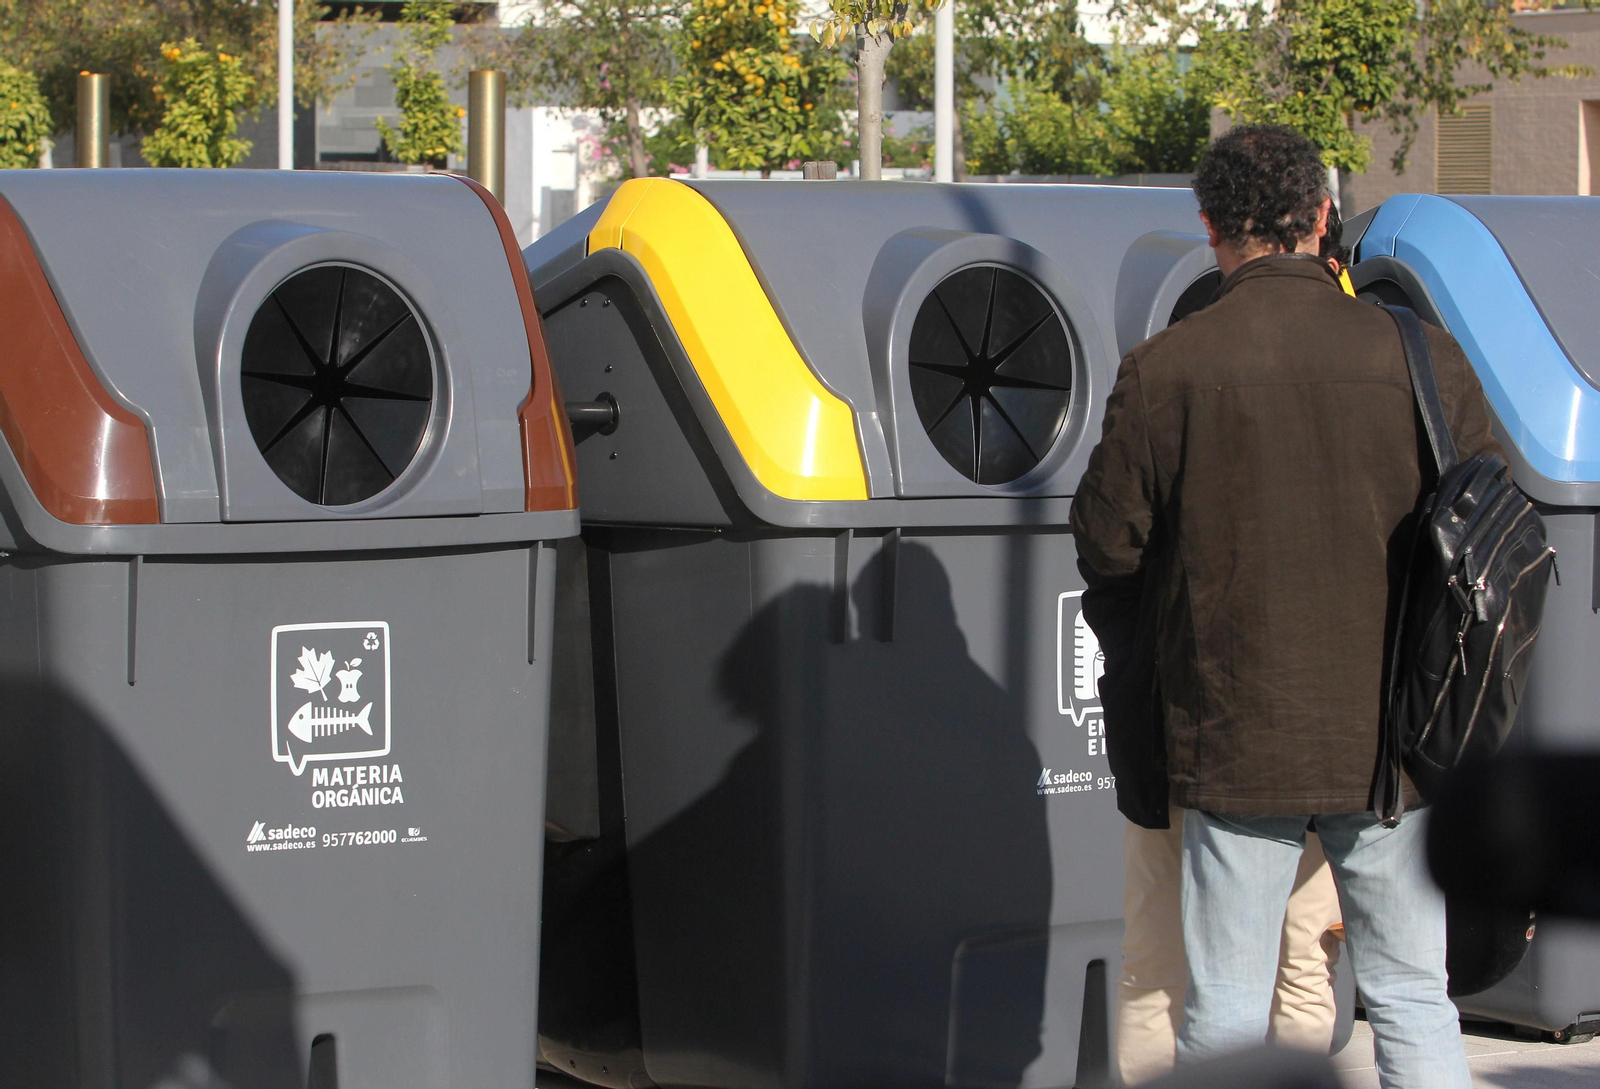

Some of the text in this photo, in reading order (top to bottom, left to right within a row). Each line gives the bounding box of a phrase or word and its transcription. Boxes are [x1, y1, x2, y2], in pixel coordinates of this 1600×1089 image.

[1088, 738, 1098, 756] E
[312, 764, 403, 787] MATERIA
[1053, 769, 1093, 785] sadeco
[311, 784, 404, 809] ORGÁNICA
[1036, 784, 1093, 796] www.sadeco.es
[268, 823, 317, 841] sadeco
[322, 829, 397, 848] 957762000
[246, 840, 316, 852] www.sadeco.es
